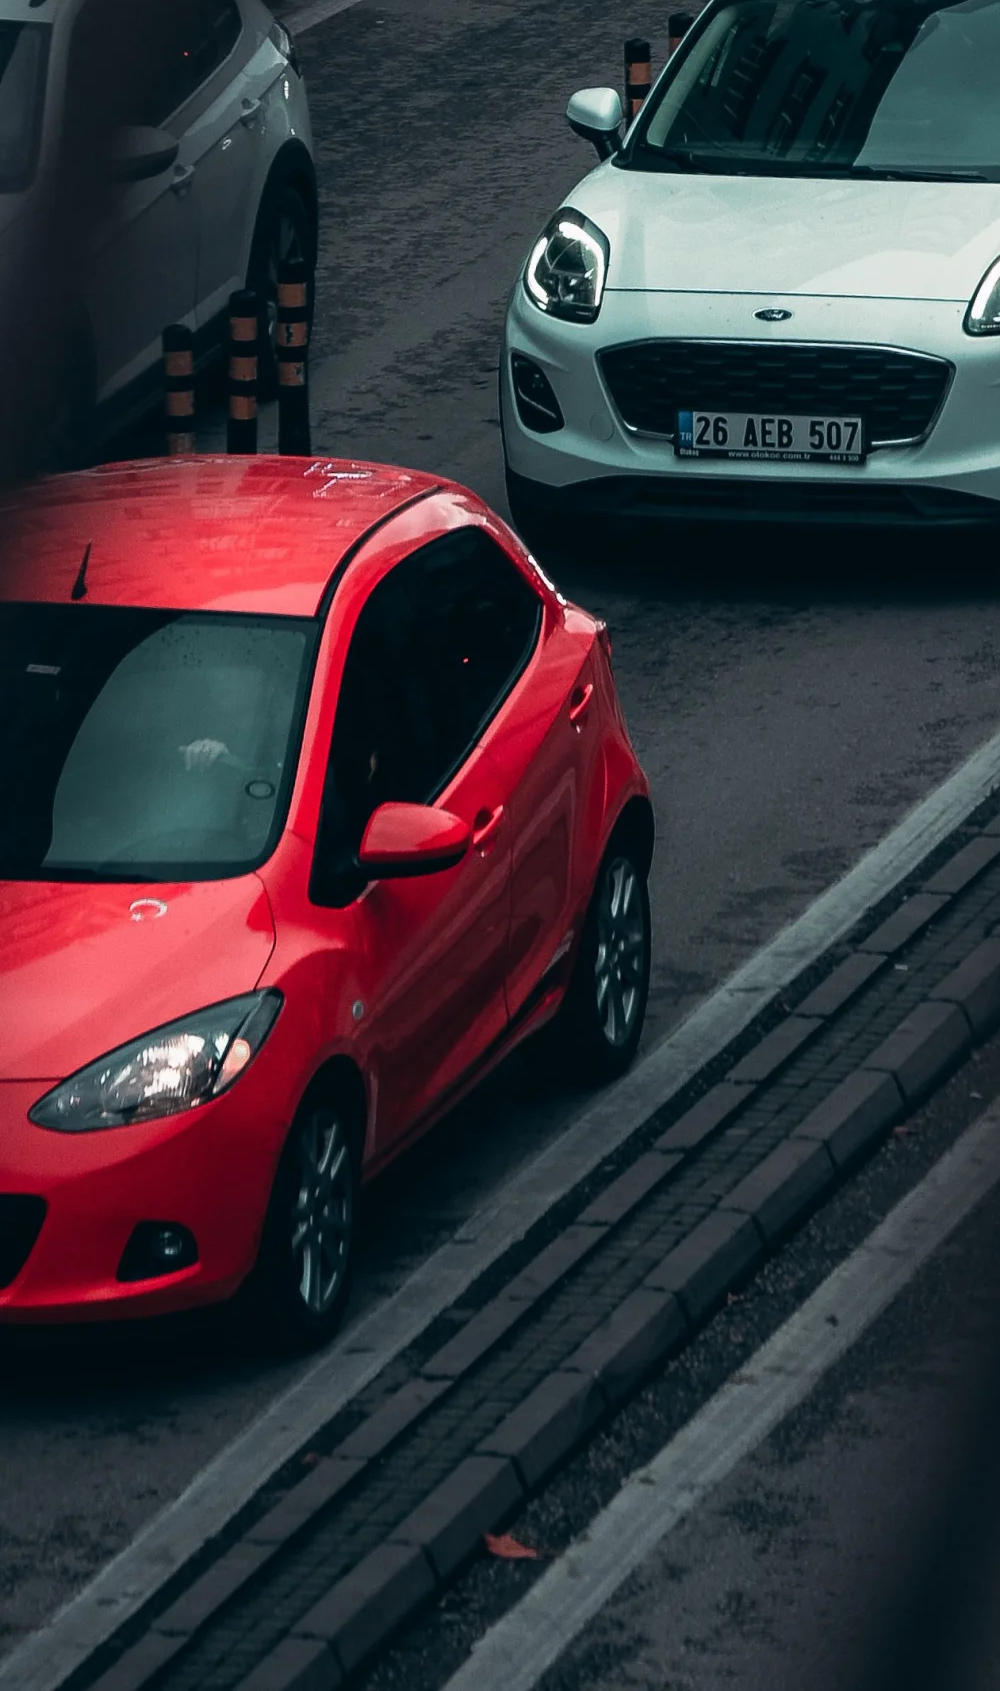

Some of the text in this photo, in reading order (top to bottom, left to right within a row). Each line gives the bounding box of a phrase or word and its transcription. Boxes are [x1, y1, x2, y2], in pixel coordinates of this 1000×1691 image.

[680, 431, 692, 441] TR
[695, 416, 860, 451] 26 AEB 507
